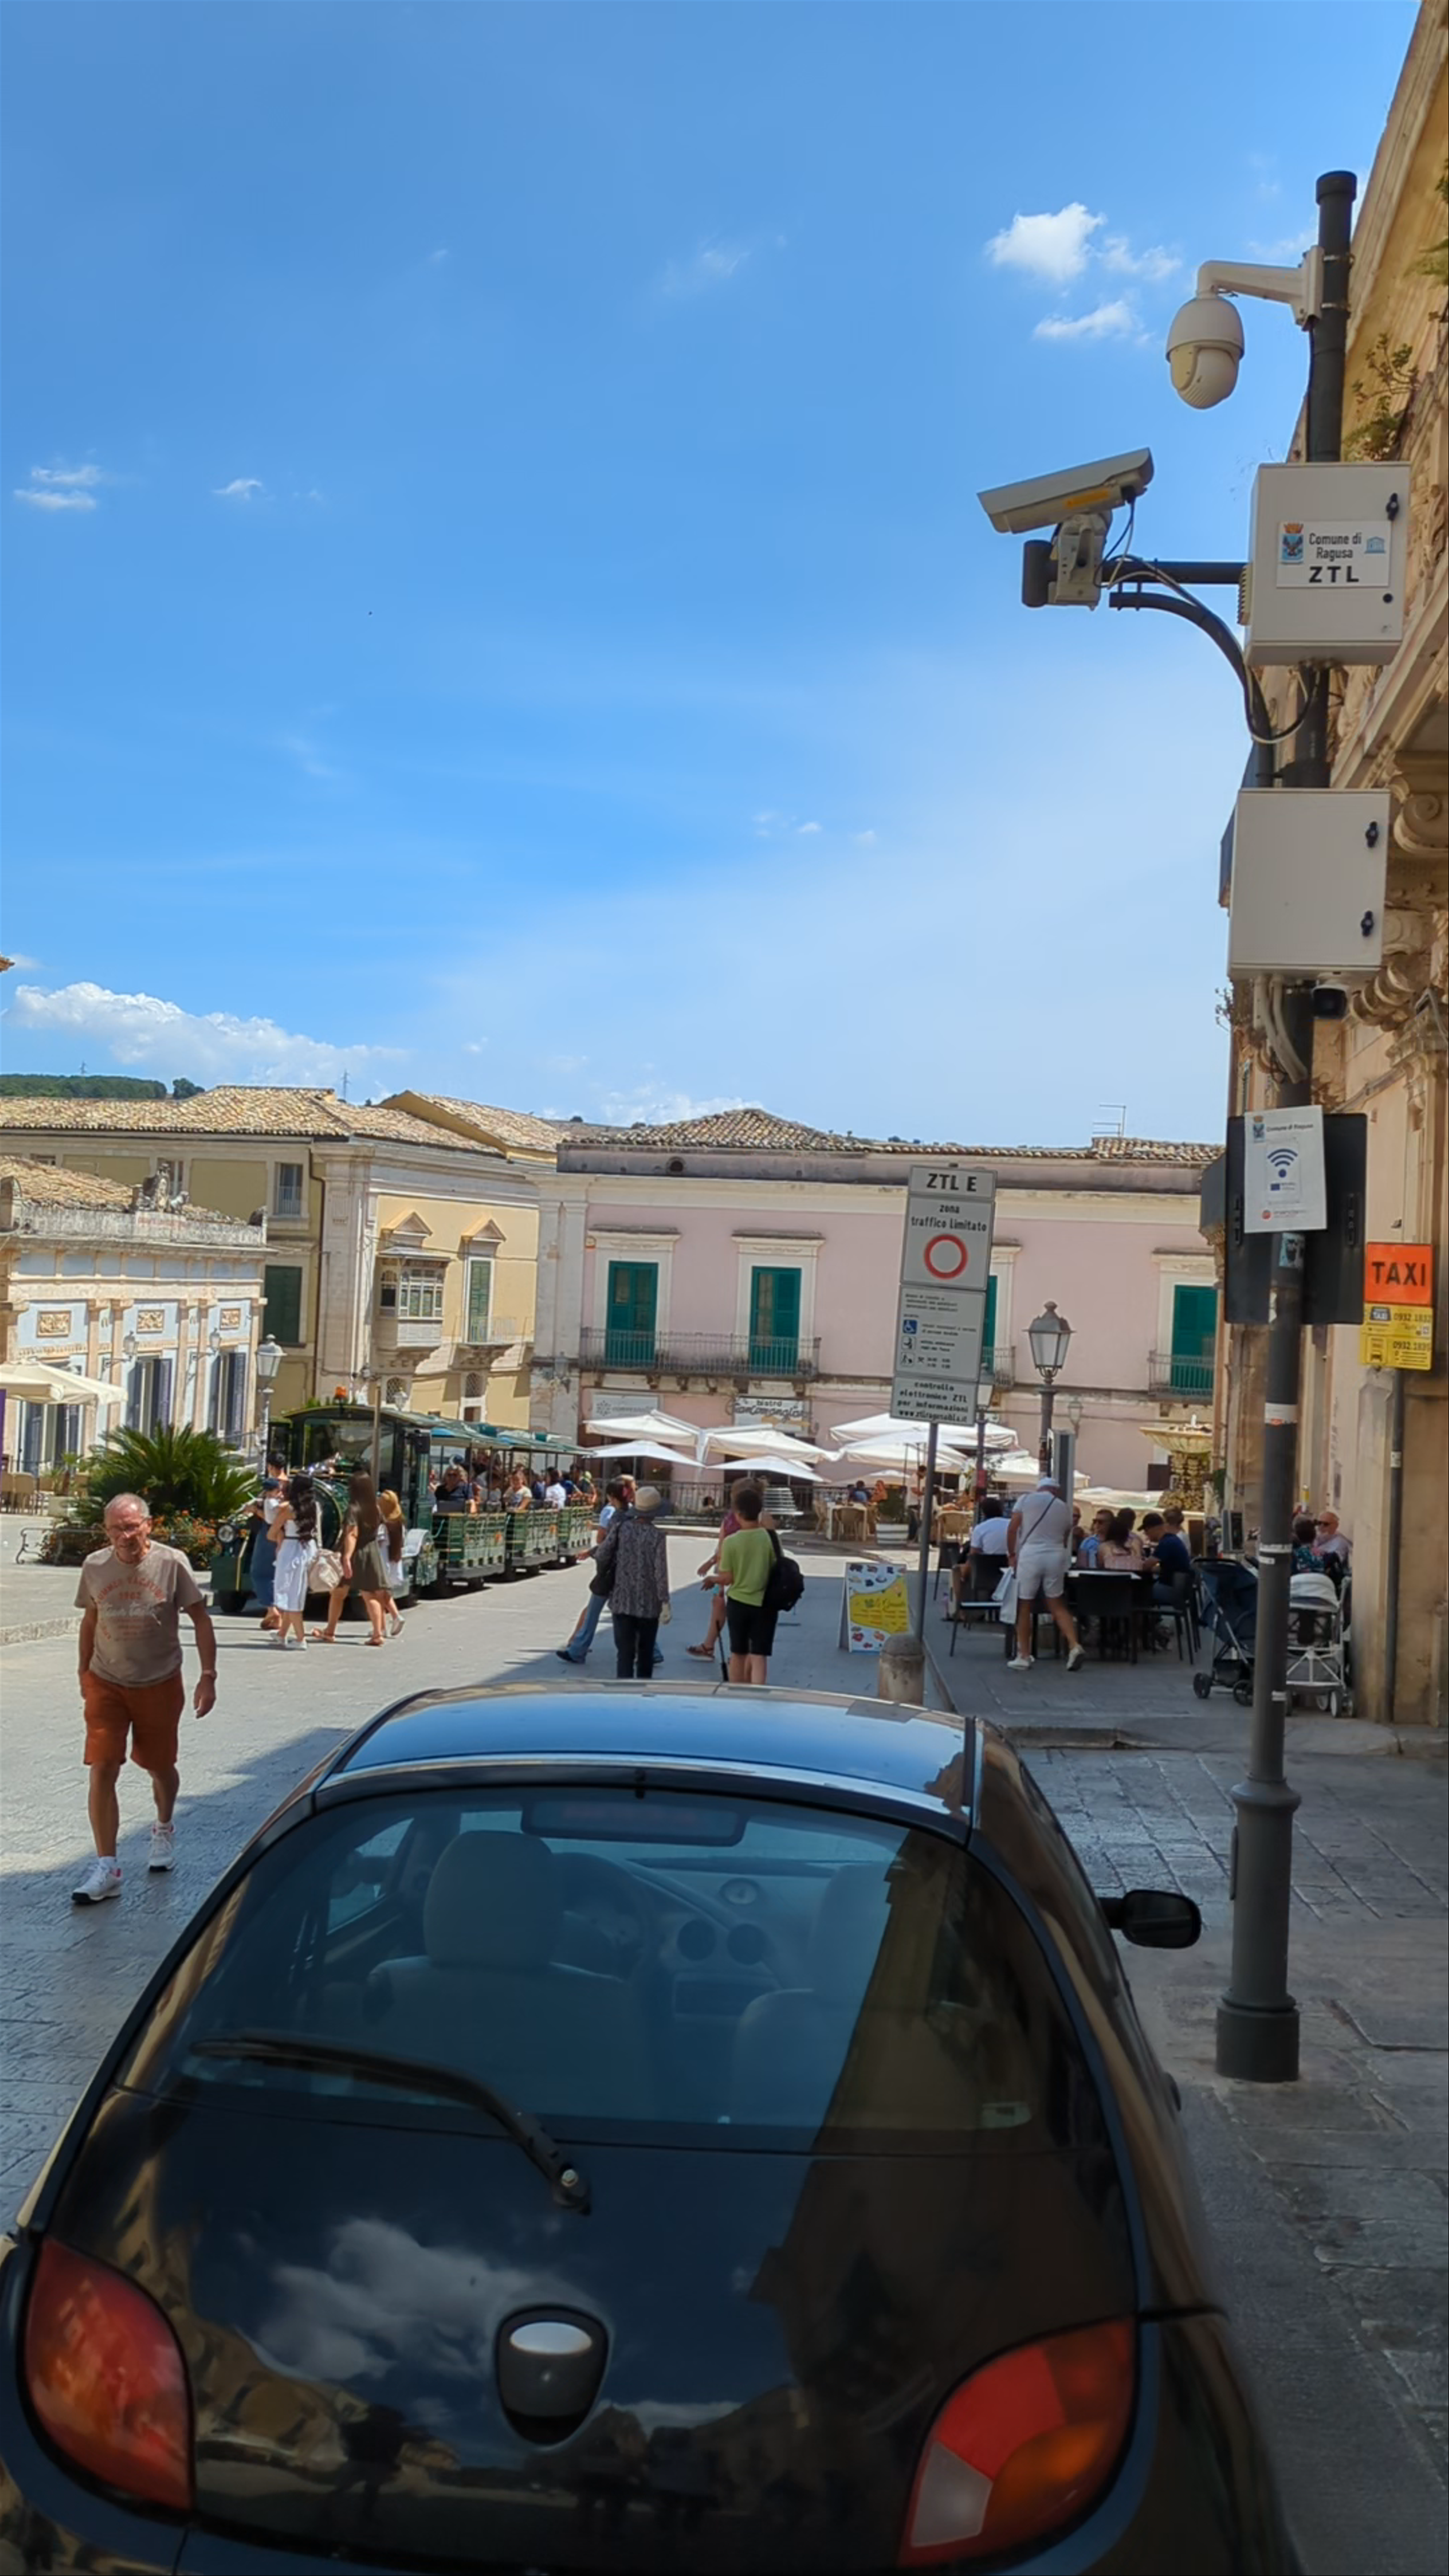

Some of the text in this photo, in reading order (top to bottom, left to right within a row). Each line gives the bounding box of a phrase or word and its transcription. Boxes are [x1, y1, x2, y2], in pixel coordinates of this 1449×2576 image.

[1309, 532, 1362, 545] Comune di
[1316, 547, 1353, 561] Ragusa
[1309, 566, 1360, 583] ZTL
[926, 1173, 977, 1192] ZTL E
[939, 1204, 960, 1213] zona
[911, 1216, 987, 1232] traffico limitato
[1371, 1261, 1426, 1287] TAXI
[914, 1382, 954, 1391] controllo
[900, 1389, 968, 1403] elettronico ZTL
[916, 1401, 969, 1413] informazioni
